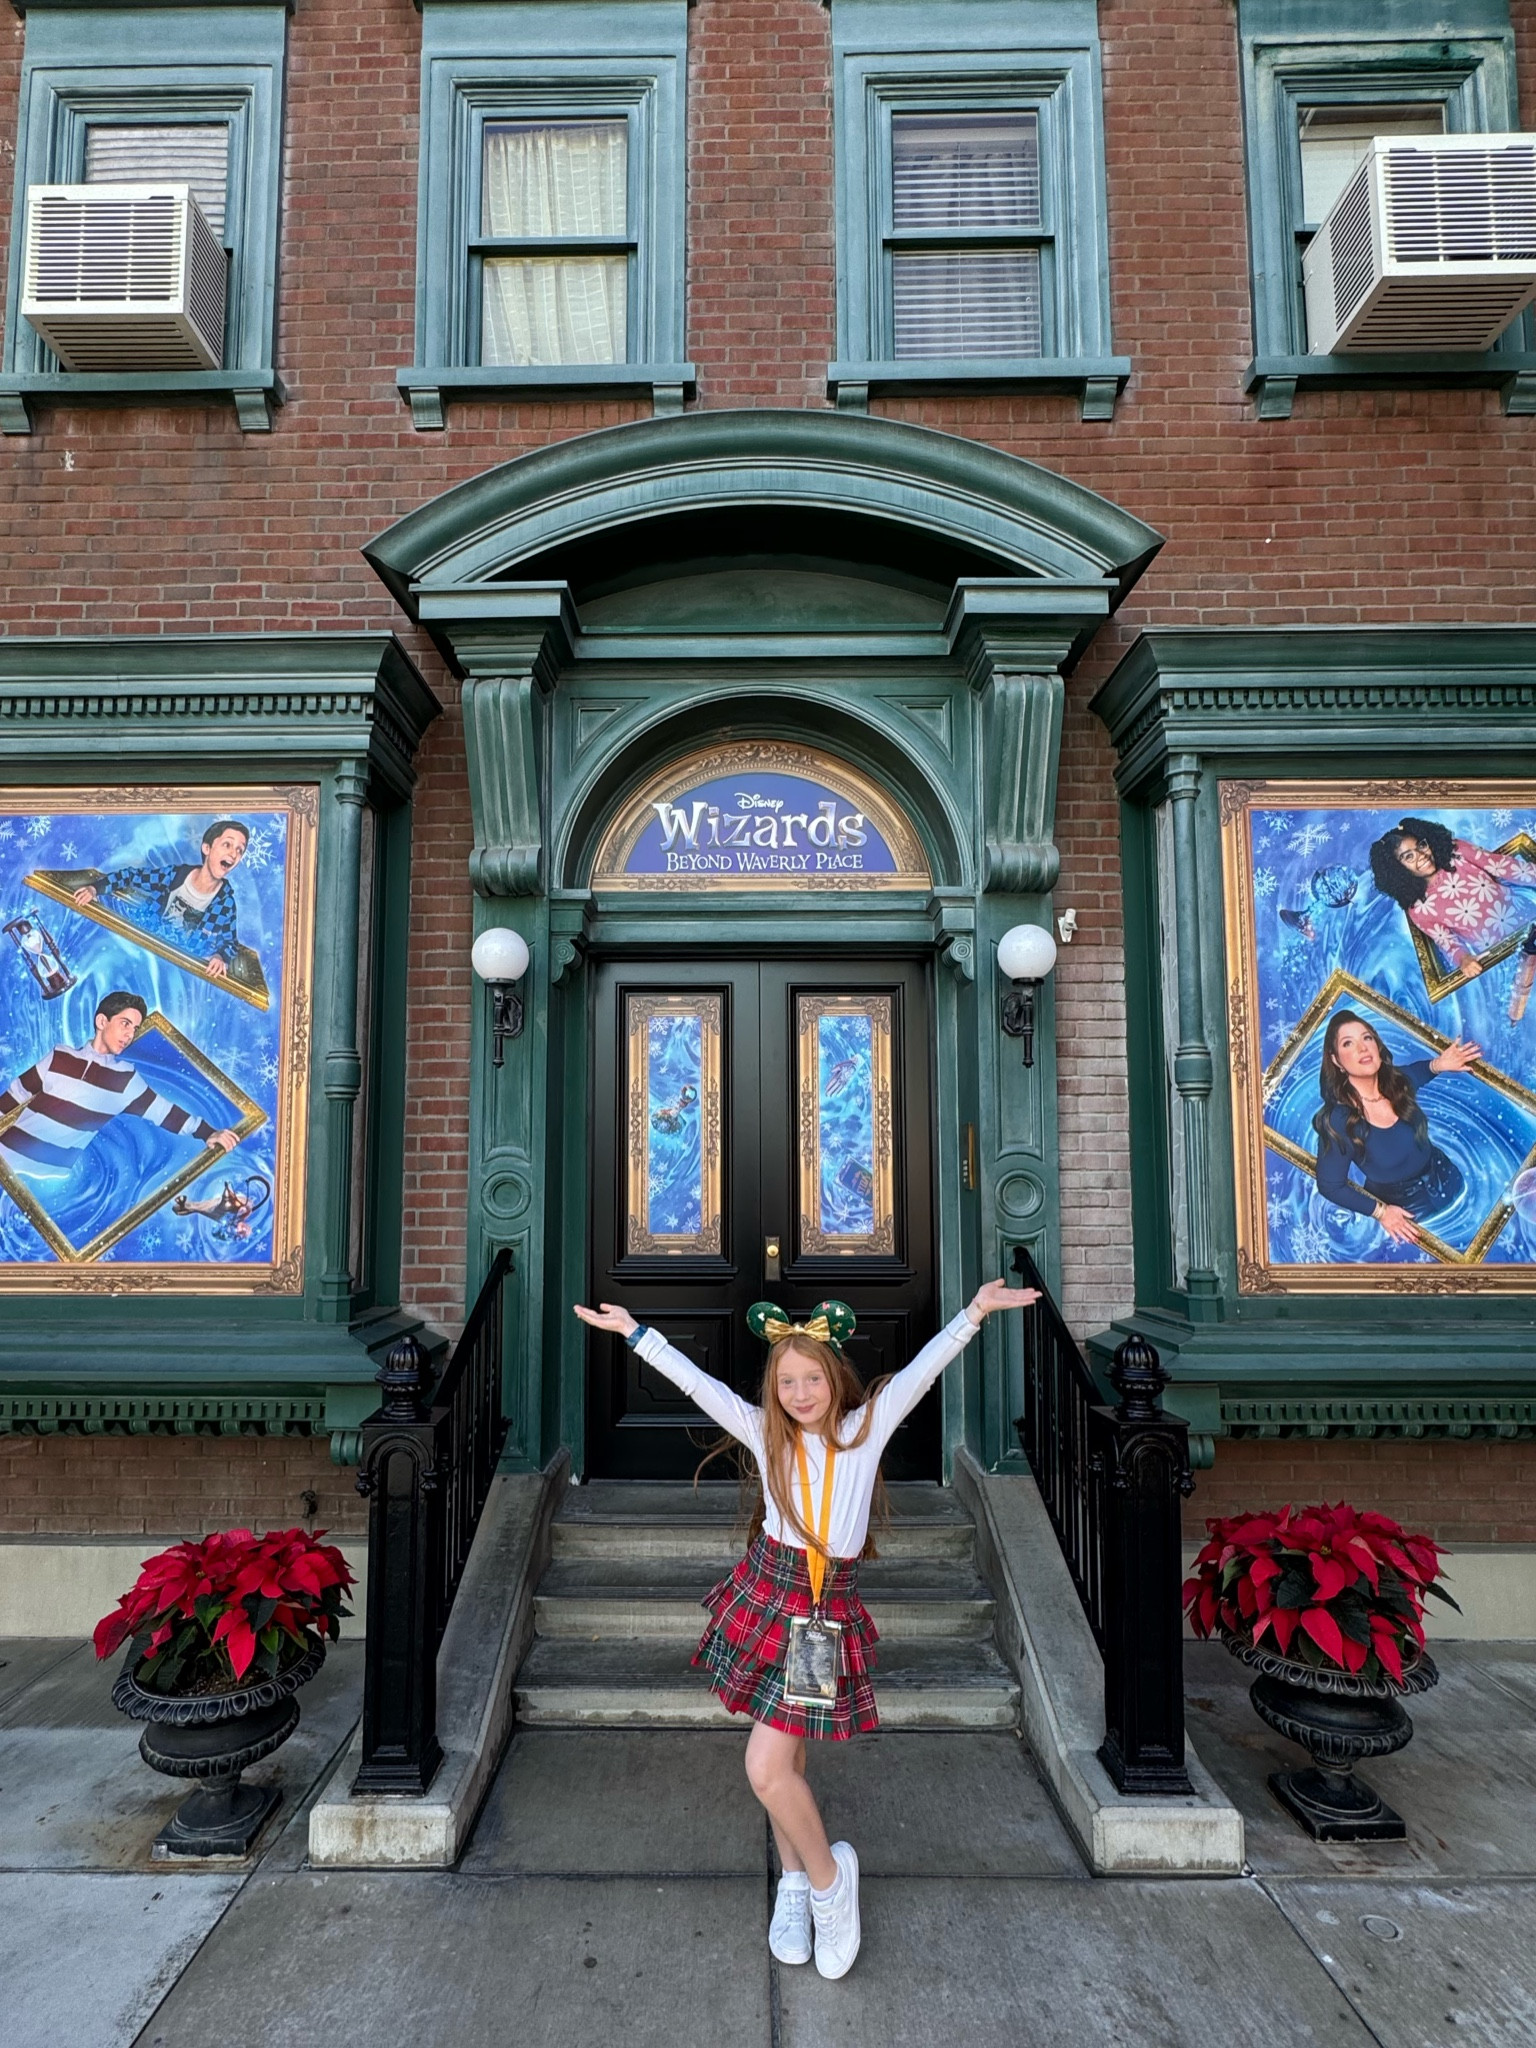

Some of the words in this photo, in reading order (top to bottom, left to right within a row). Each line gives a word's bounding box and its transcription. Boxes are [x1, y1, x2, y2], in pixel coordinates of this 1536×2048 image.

[734, 792, 784, 814] Disney
[652, 800, 868, 851] Wizards
[666, 852, 733, 872] BEYOND
[735, 852, 811, 872] WAVERLY
[815, 852, 863, 870] PLACE
